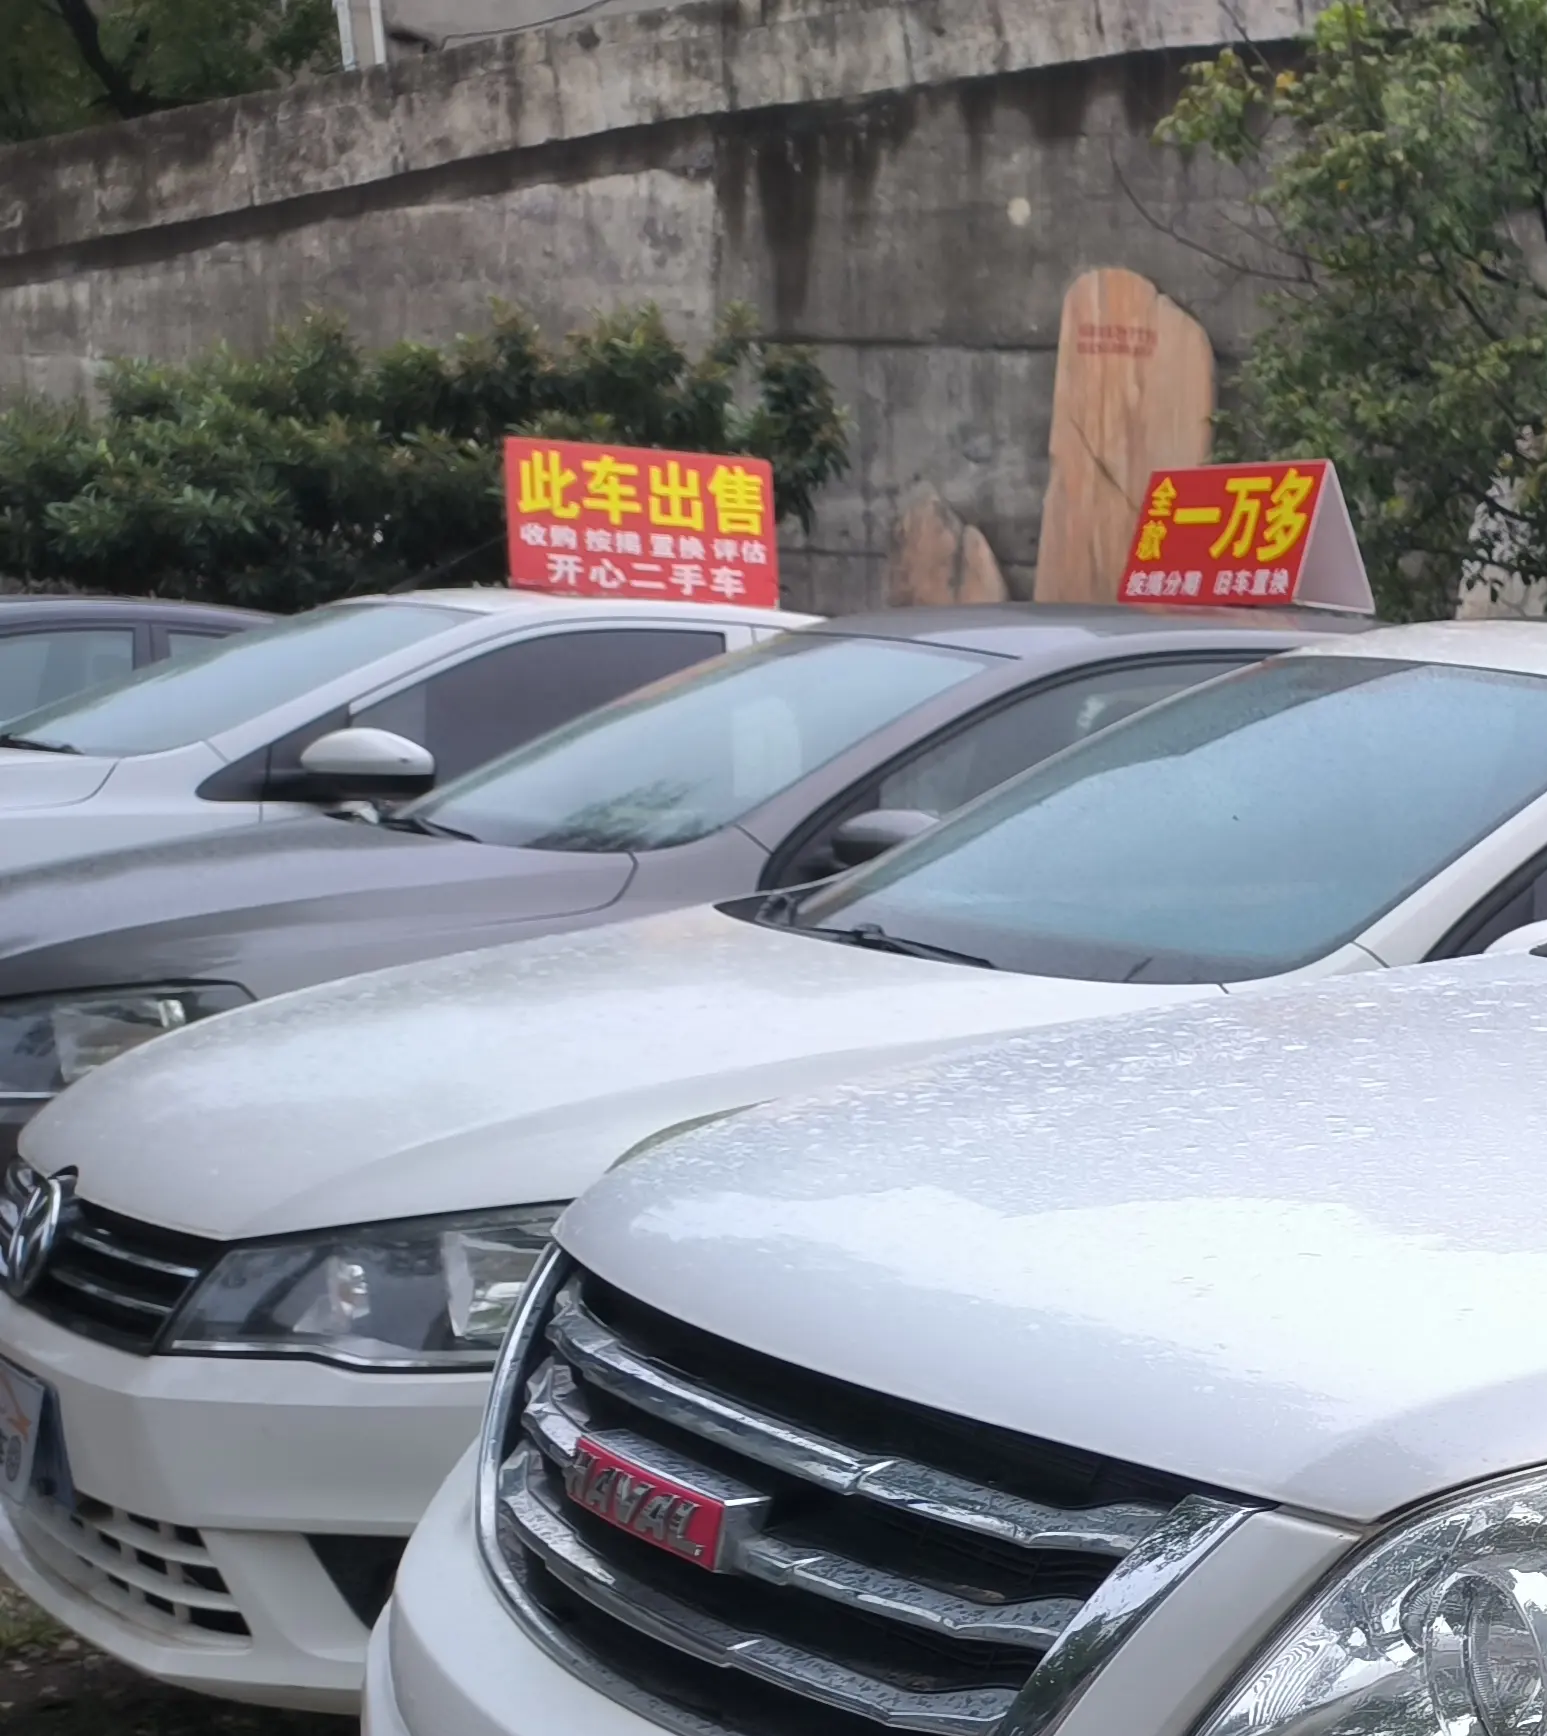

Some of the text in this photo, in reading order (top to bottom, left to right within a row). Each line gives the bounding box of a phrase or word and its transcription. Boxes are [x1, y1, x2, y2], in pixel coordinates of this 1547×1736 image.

[516, 449, 766, 537] 此车出售
[1172, 467, 1315, 562] 一万多
[546, 552, 747, 599] 开心二手车
[566, 1448, 705, 1557] HAVAL
